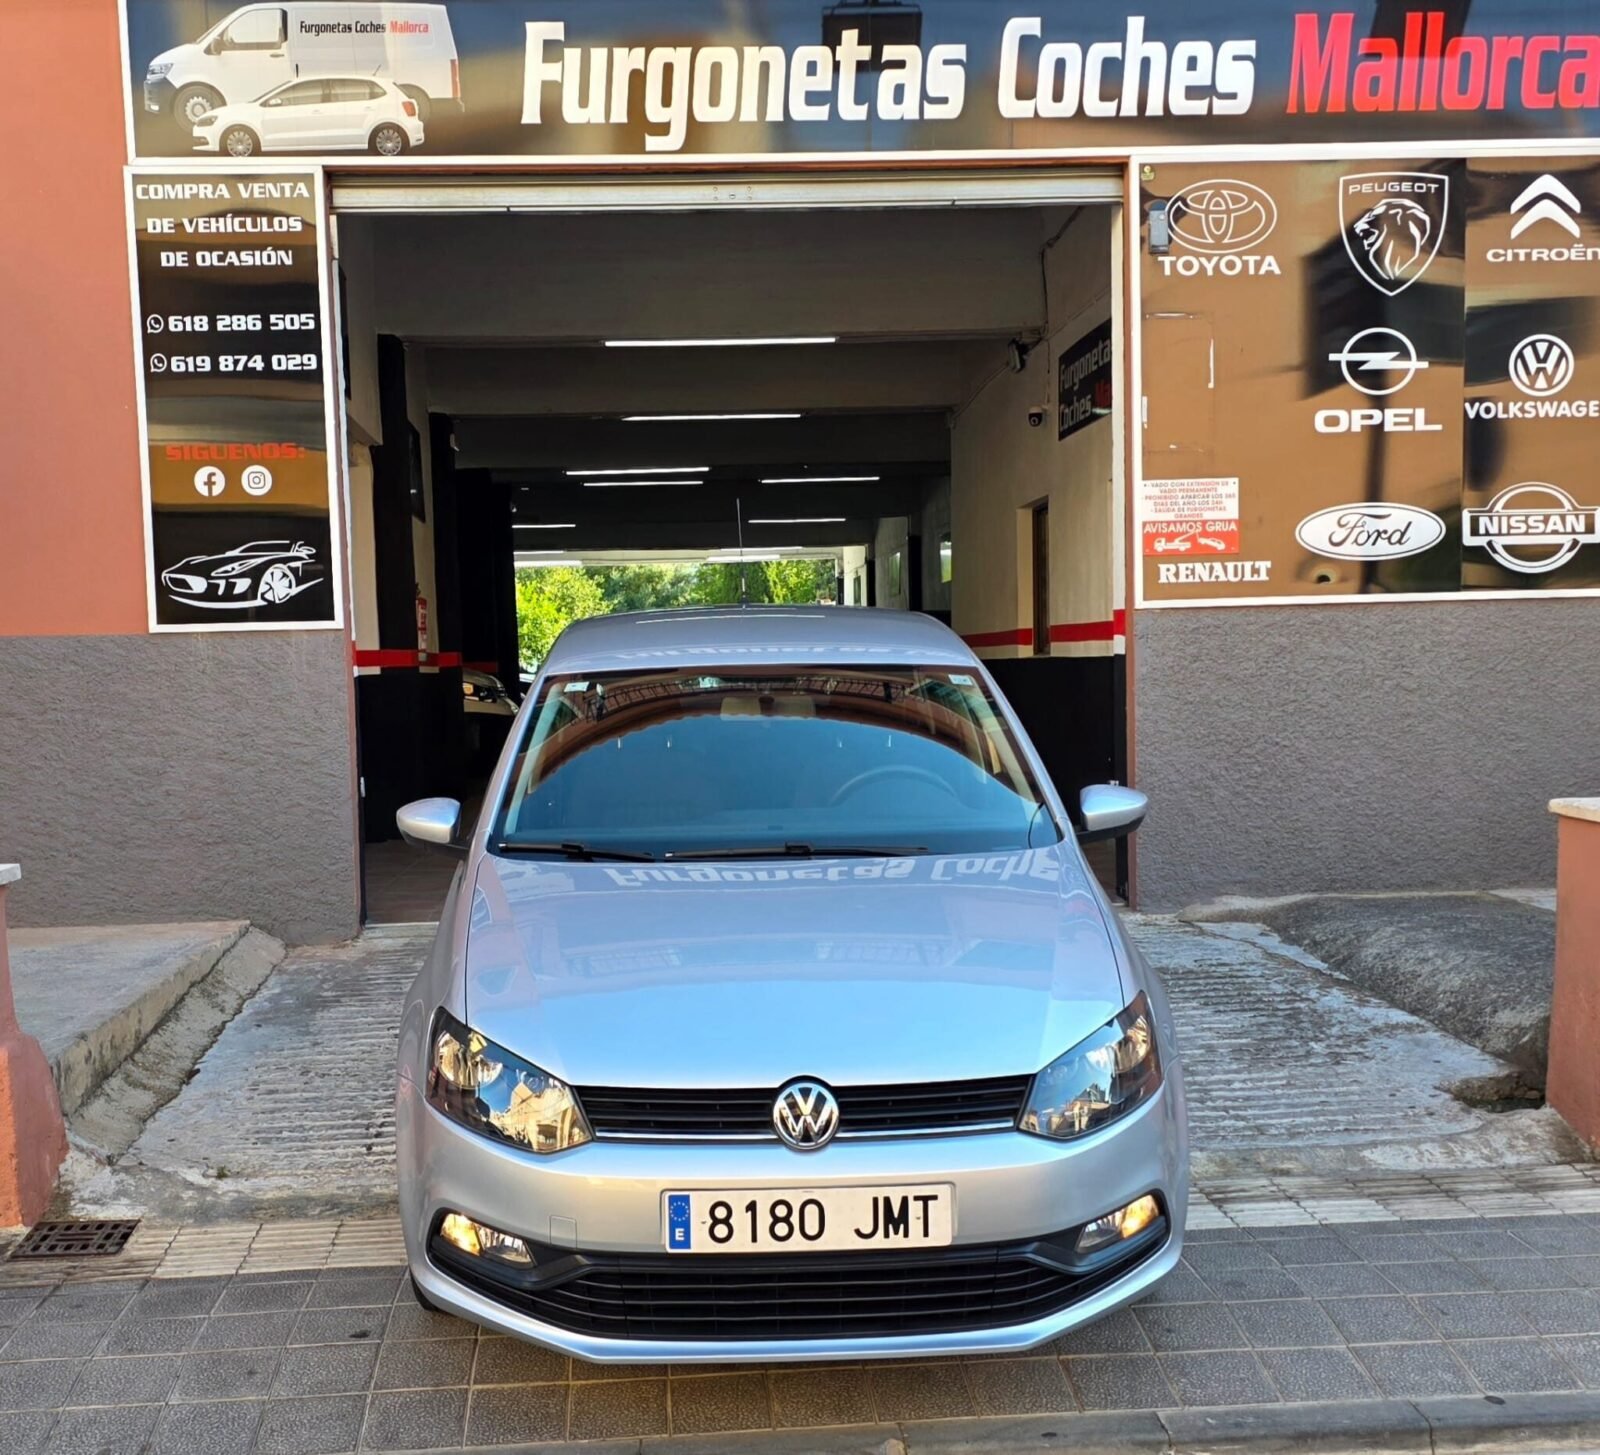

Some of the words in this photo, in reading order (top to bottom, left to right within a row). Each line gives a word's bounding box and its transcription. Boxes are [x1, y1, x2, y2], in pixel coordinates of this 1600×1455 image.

[300, 20, 352, 36] Furgonetas
[355, 21, 386, 33] Coches
[390, 20, 429, 33] Mallorca
[520, 19, 968, 152] Furgonetas
[997, 15, 1256, 119] Coches
[1286, 12, 1600, 114] Mallorca
[135, 183, 231, 199] COMPRA
[237, 182, 310, 198] VENTA
[1349, 182, 1440, 194] PEUGEOT
[147, 218, 175, 233] DE
[182, 214, 303, 232] VEHÍCULOS
[160, 251, 188, 267] DE
[196, 247, 293, 266] OCASIÓN
[1157, 254, 1282, 276] TOYOTA
[168, 315, 209, 332] 618
[216, 315, 262, 331] 286
[269, 314, 315, 330] 505
[171, 355, 211, 372] 619
[219, 355, 264, 371] 874
[272, 354, 317, 370] 029
[1314, 408, 1442, 433] OPEL
[1143, 522, 1202, 534] AVISAMOS
[1205, 521, 1238, 532] GRUA
[1328, 512, 1412, 548] Ford
[1478, 514, 1586, 535] NISSAN
[1157, 560, 1272, 583] RENAULT
[708, 1199, 826, 1243] 8180
[854, 1194, 939, 1240] JMT
